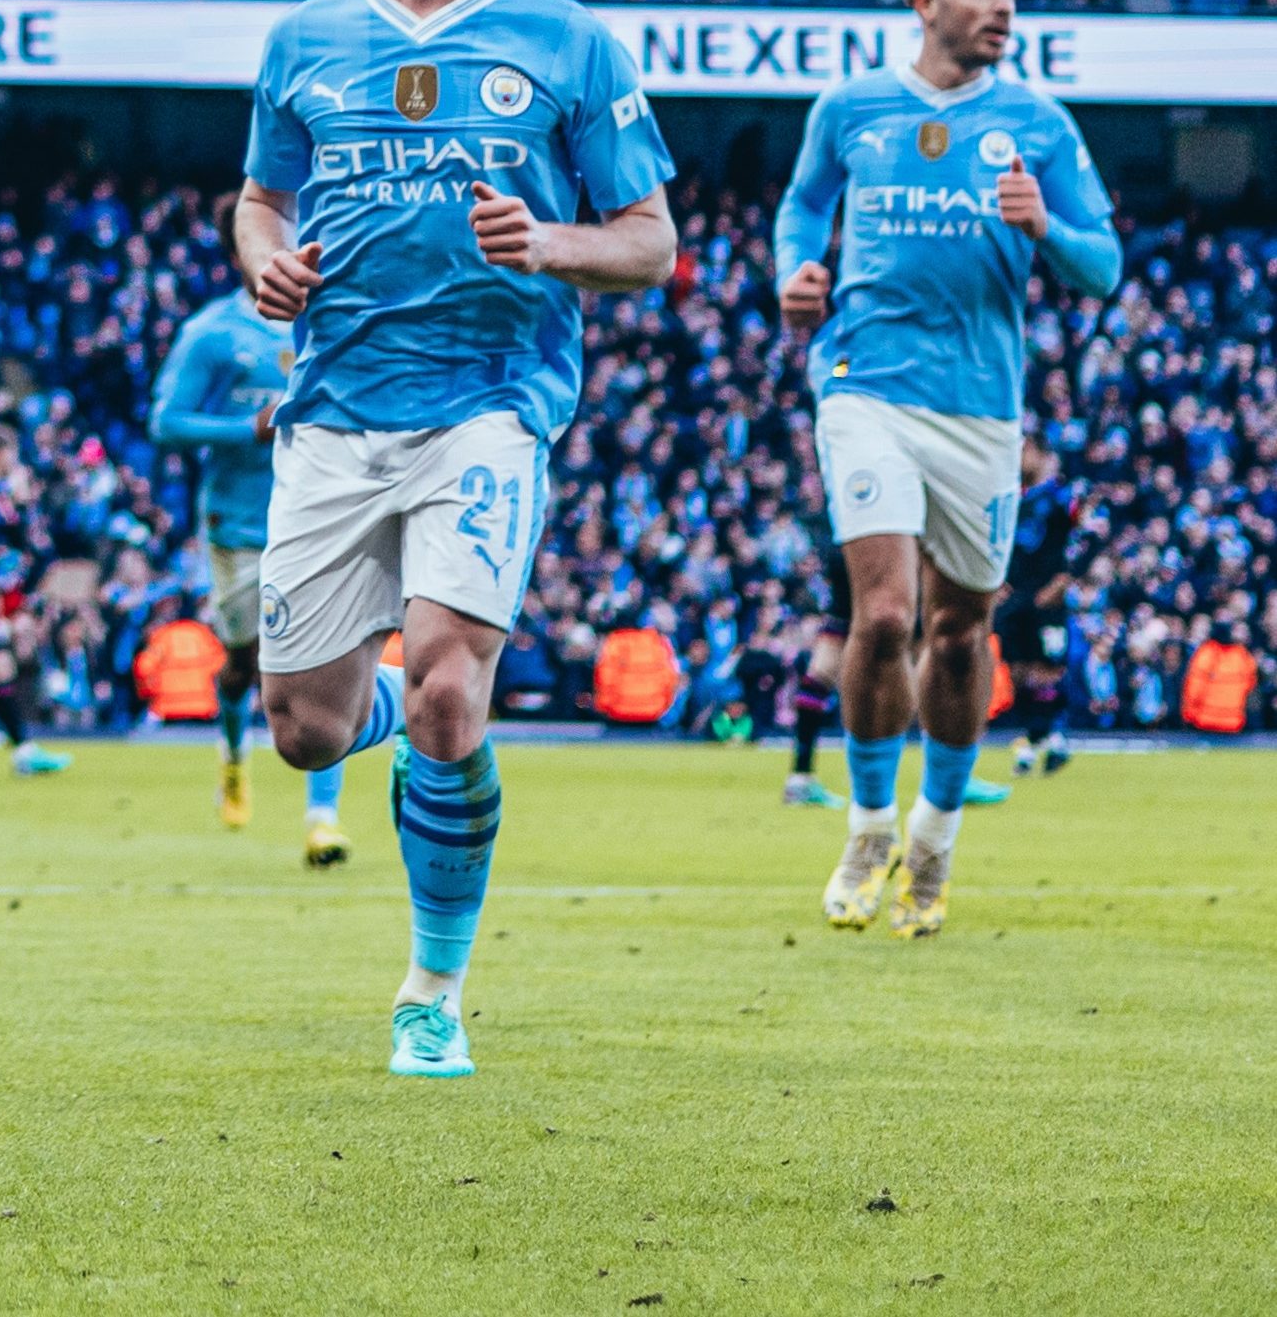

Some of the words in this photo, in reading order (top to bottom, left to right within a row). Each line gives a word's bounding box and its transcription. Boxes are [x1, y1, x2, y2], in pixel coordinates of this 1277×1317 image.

[640, 21, 887, 80] NEXEN
[316, 137, 528, 181] ETIHAD
[346, 181, 469, 203] AIRWAY
[877, 218, 984, 238] AIRWAYS
[456, 464, 525, 551] 21
